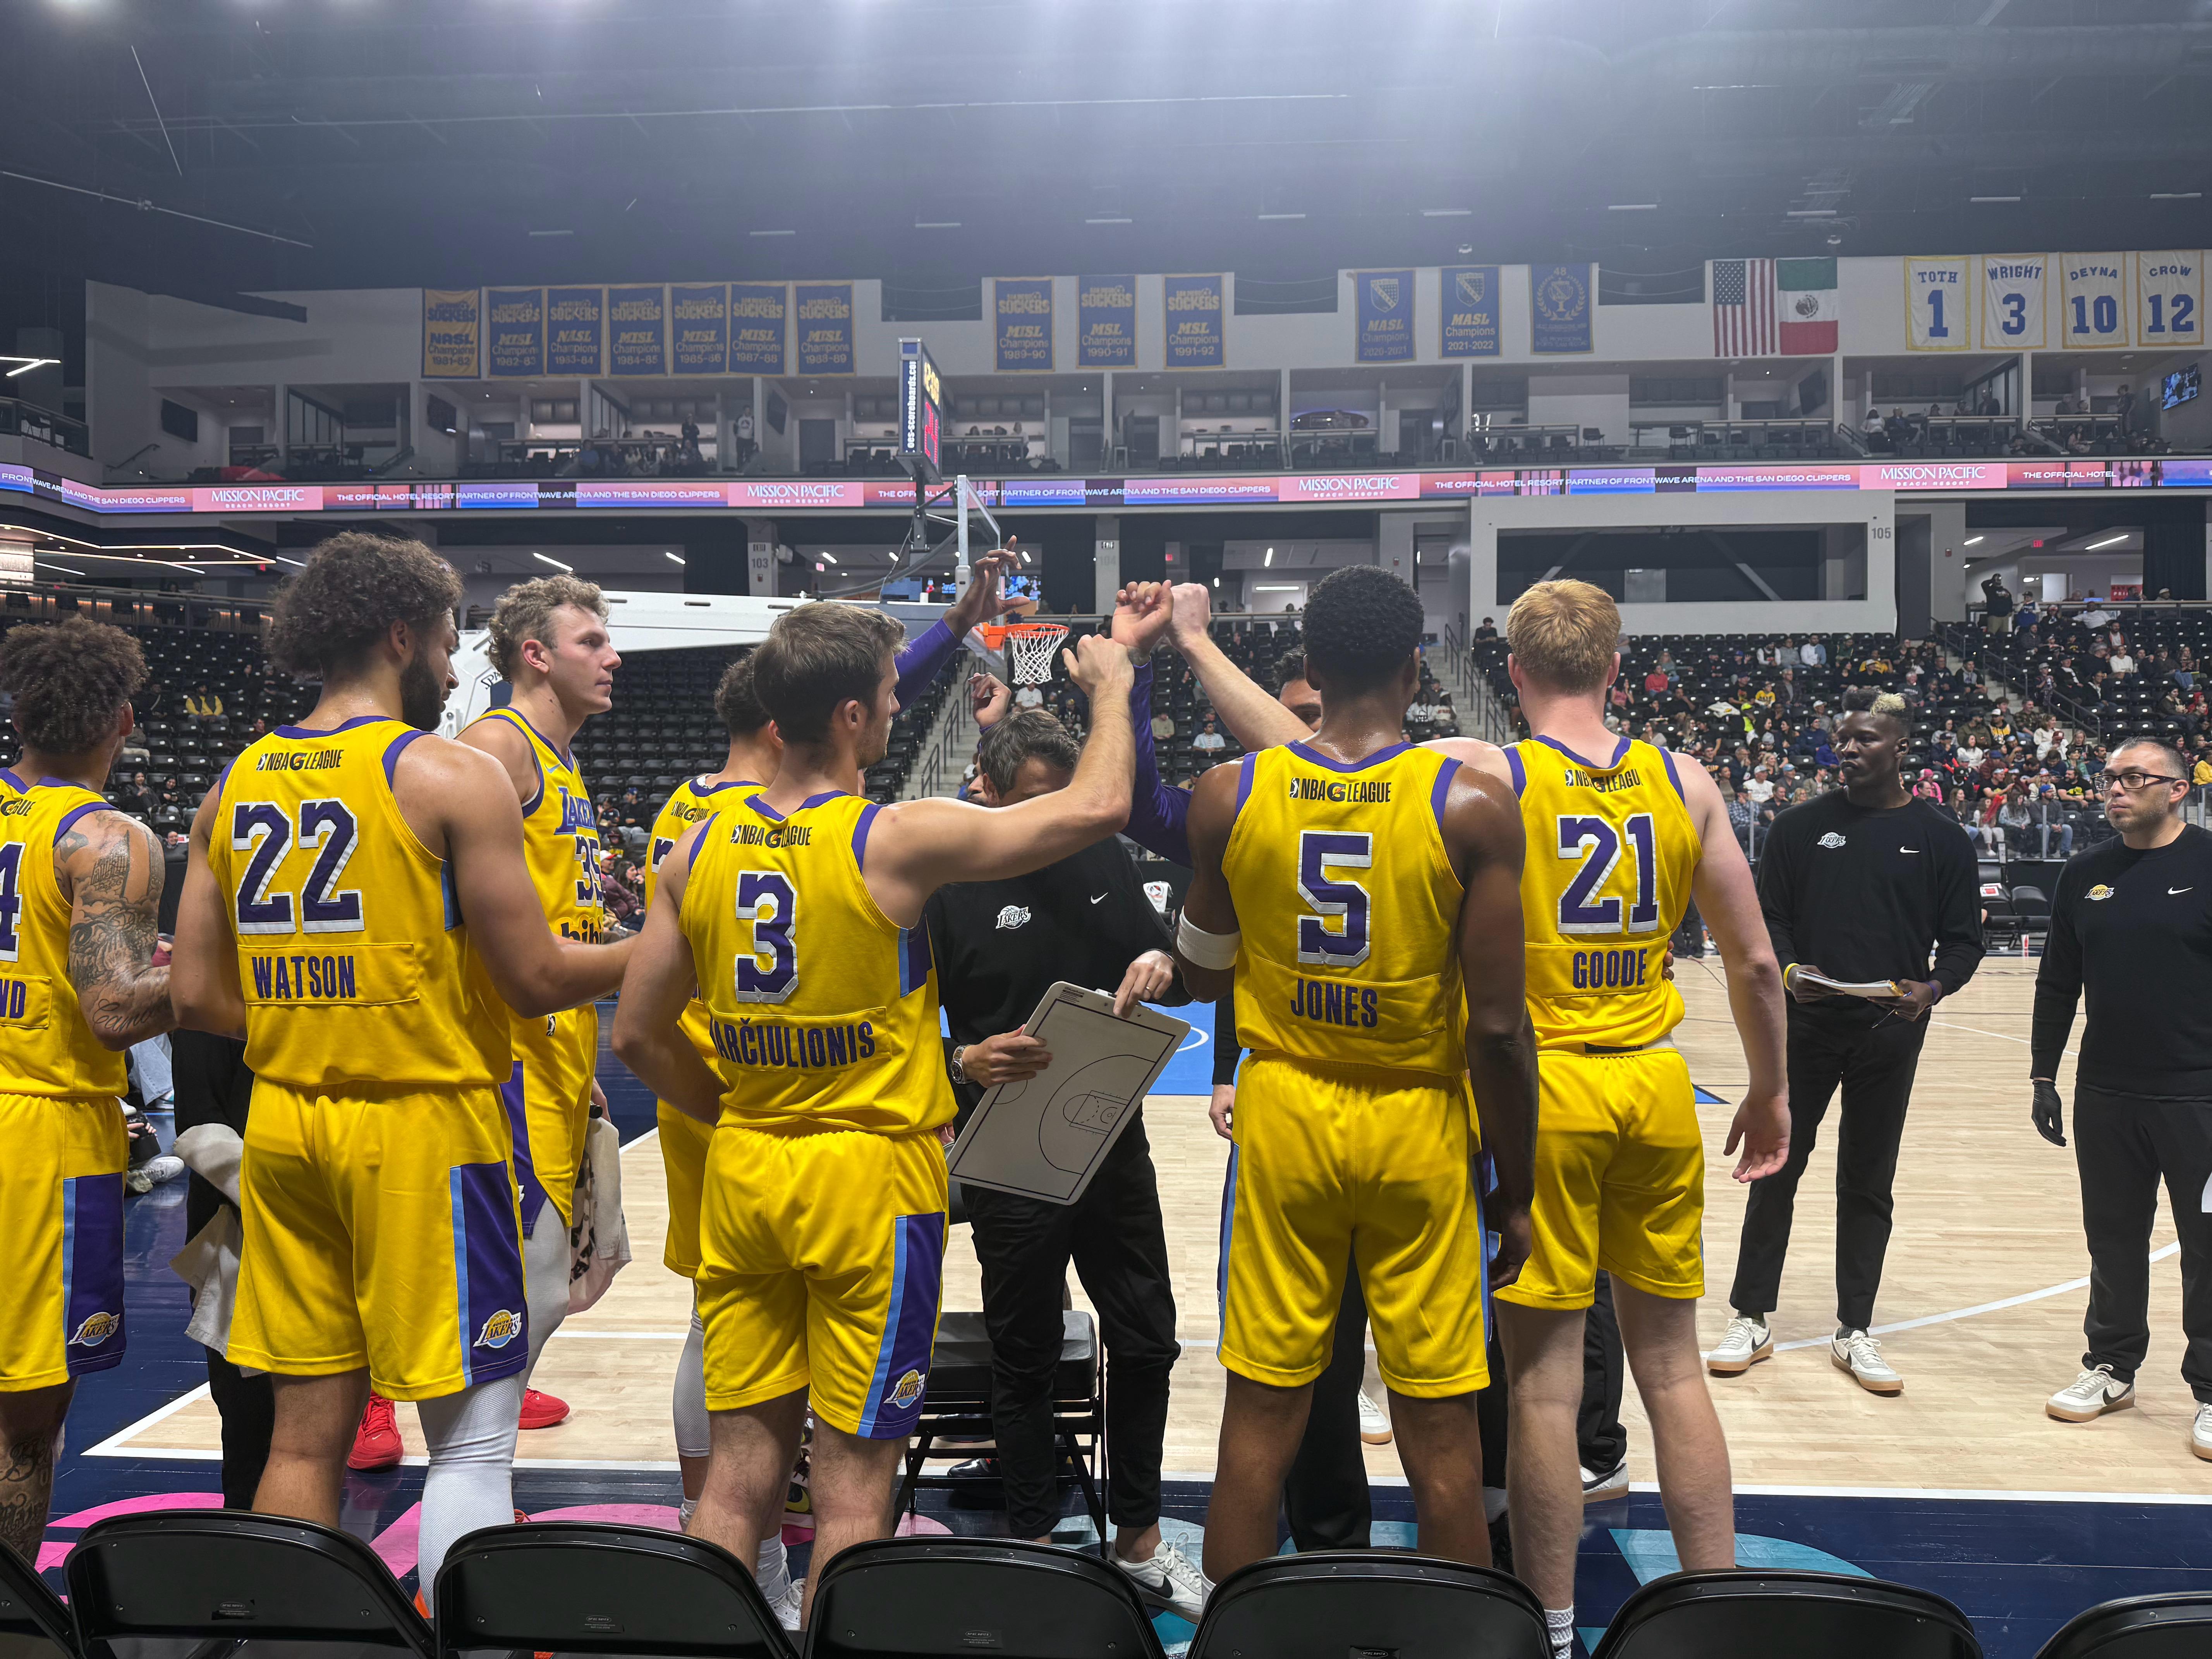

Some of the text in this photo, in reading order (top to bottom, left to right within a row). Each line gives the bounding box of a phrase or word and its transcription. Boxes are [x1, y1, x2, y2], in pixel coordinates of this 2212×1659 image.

[1918, 270, 1958, 283] TOTH
[1987, 265, 2043, 281] WRIGHT
[2070, 267, 2118, 281] DEYNA
[2150, 265, 2191, 277] CROW
[998, 300, 1050, 314] SOCKERS
[1082, 293, 1133, 308] SOCKERS
[1168, 295, 1219, 311] SOCKERS
[550, 307, 599, 321] SOCKERS
[733, 303, 783, 318] SOCKERS
[799, 304, 849, 319] SOCKERS
[1928, 290, 1948, 338] 1
[2002, 293, 2026, 335] 3
[2071, 295, 2117, 334] 10
[2148, 294, 2194, 333] 12
[1367, 319, 1404, 331] MASL
[1451, 313, 1489, 325] MASL
[739, 329, 776, 341] MISL
[1006, 326, 1043, 338] MISL
[1091, 323, 1122, 335] MSL
[1178, 322, 1209, 334] MSL
[1446, 326, 1495, 337] Champions
[557, 330, 591, 342] NASL
[682, 330, 717, 342] MISL
[807, 330, 843, 342] MISL
[1082, 336, 1132, 346] Champions
[1169, 334, 1219, 345] Champions
[551, 342, 598, 353] Champions
[999, 338, 1048, 349] Champions
[1448, 340, 1494, 350] 2021-2022
[1003, 350, 1046, 359] 1989-90
[1087, 347, 1127, 357] 1990-91
[1175, 347, 1214, 356] 1991-92
[1881, 467, 1986, 479] MISSION PACIFIC
[2, 473, 51, 489] FRONTWAVE
[52, 484, 73, 495] ARENA
[74, 491, 87, 500] AND
[88, 494, 100, 503] THE
[747, 485, 844, 497] MISSION PACIFIC
[1299, 477, 1399, 491] MISSION PACIFIC
[211, 489, 304, 501] MISSION PACIFIC
[1872, 527, 1891, 539] 105
[752, 558, 768, 568] 103
[269, 752, 289, 770] NBA
[304, 749, 345, 770] LEAGUE
[1607, 769, 1644, 793] LEAGU
[1301, 778, 1326, 801] NBA
[1346, 781, 1392, 803] LEAGUE
[740, 824, 765, 846] NBA
[232, 797, 366, 934] 22
[574, 834, 603, 907] 35
[1556, 812, 1659, 933] 21
[1297, 830, 1373, 967] 5
[997, 909, 1030, 927] LAKERS
[734, 869, 799, 1003] 3
[252, 955, 356, 999] WATSON
[1290, 978, 1378, 1028] JONES
[70, 1320, 117, 1343] LAKERS
[476, 1320, 520, 1344] LAKERS
[886, 1380, 925, 1402] LAKERS
